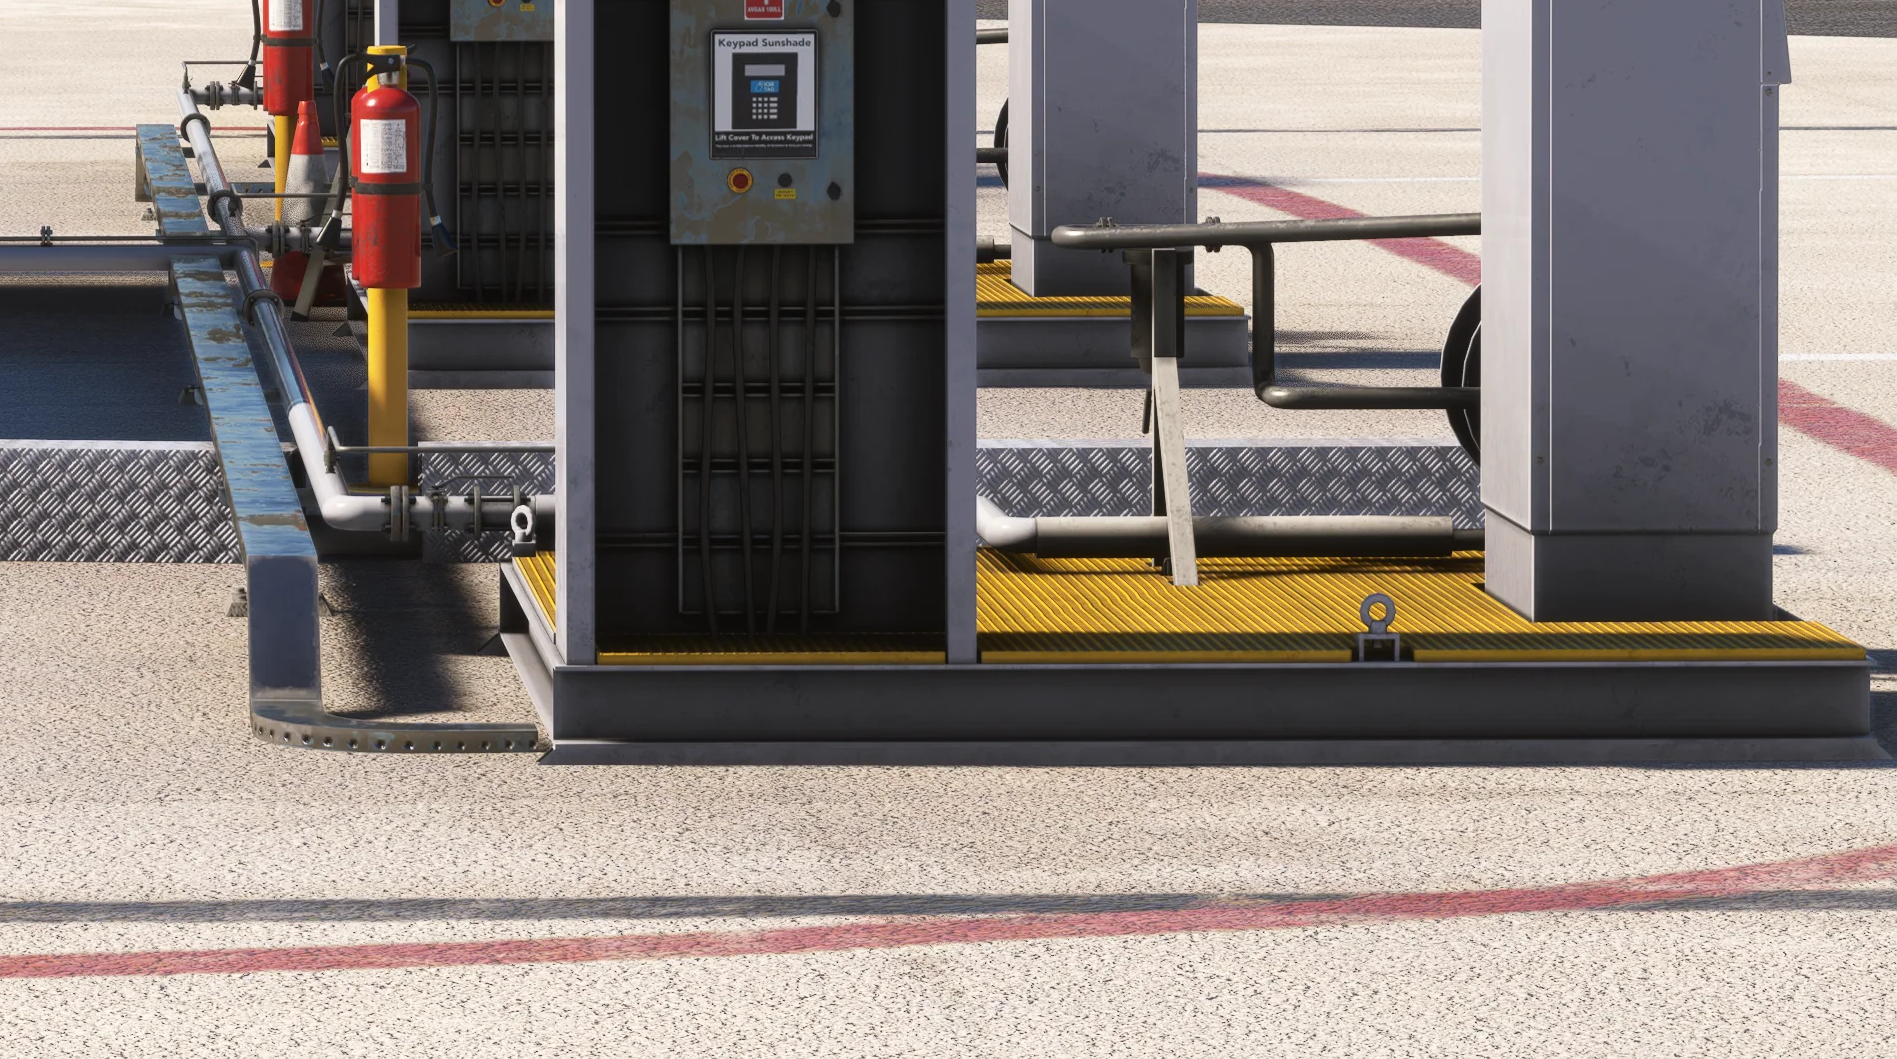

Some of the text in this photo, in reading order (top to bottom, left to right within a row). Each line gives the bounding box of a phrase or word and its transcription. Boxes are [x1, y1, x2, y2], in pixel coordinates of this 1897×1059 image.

[718, 38, 812, 50] Keypad Sunshade
[786, 134, 814, 142] Keypad
